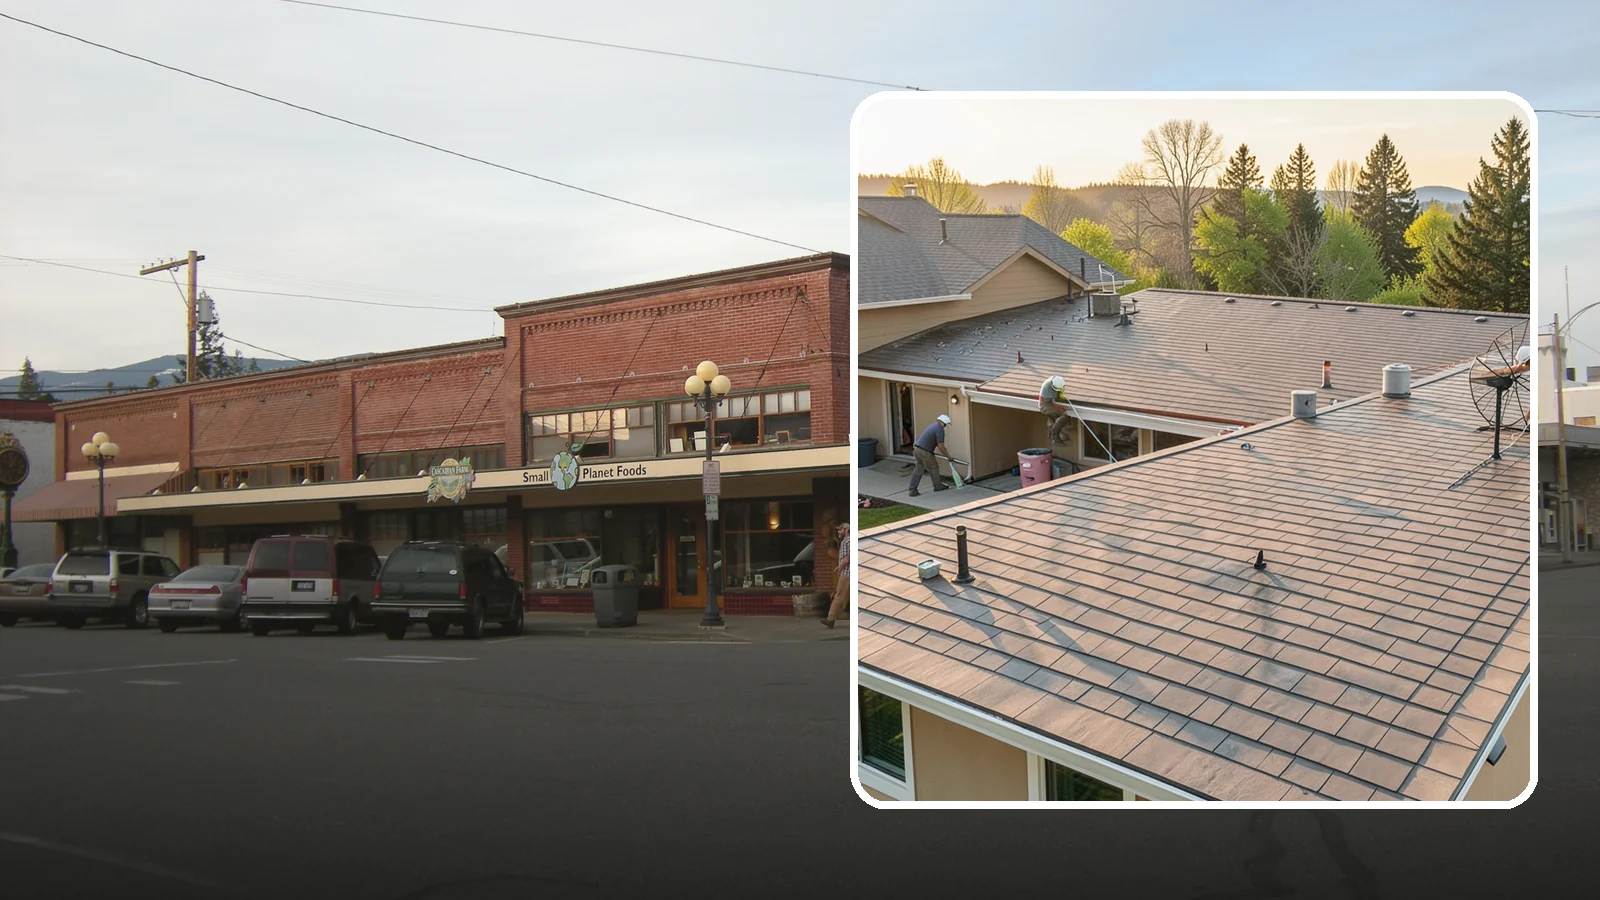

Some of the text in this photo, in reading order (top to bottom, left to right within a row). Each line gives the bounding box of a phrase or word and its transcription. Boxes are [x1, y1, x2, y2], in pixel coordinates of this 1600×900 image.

[523, 464, 647, 483] Small Planet Foods
